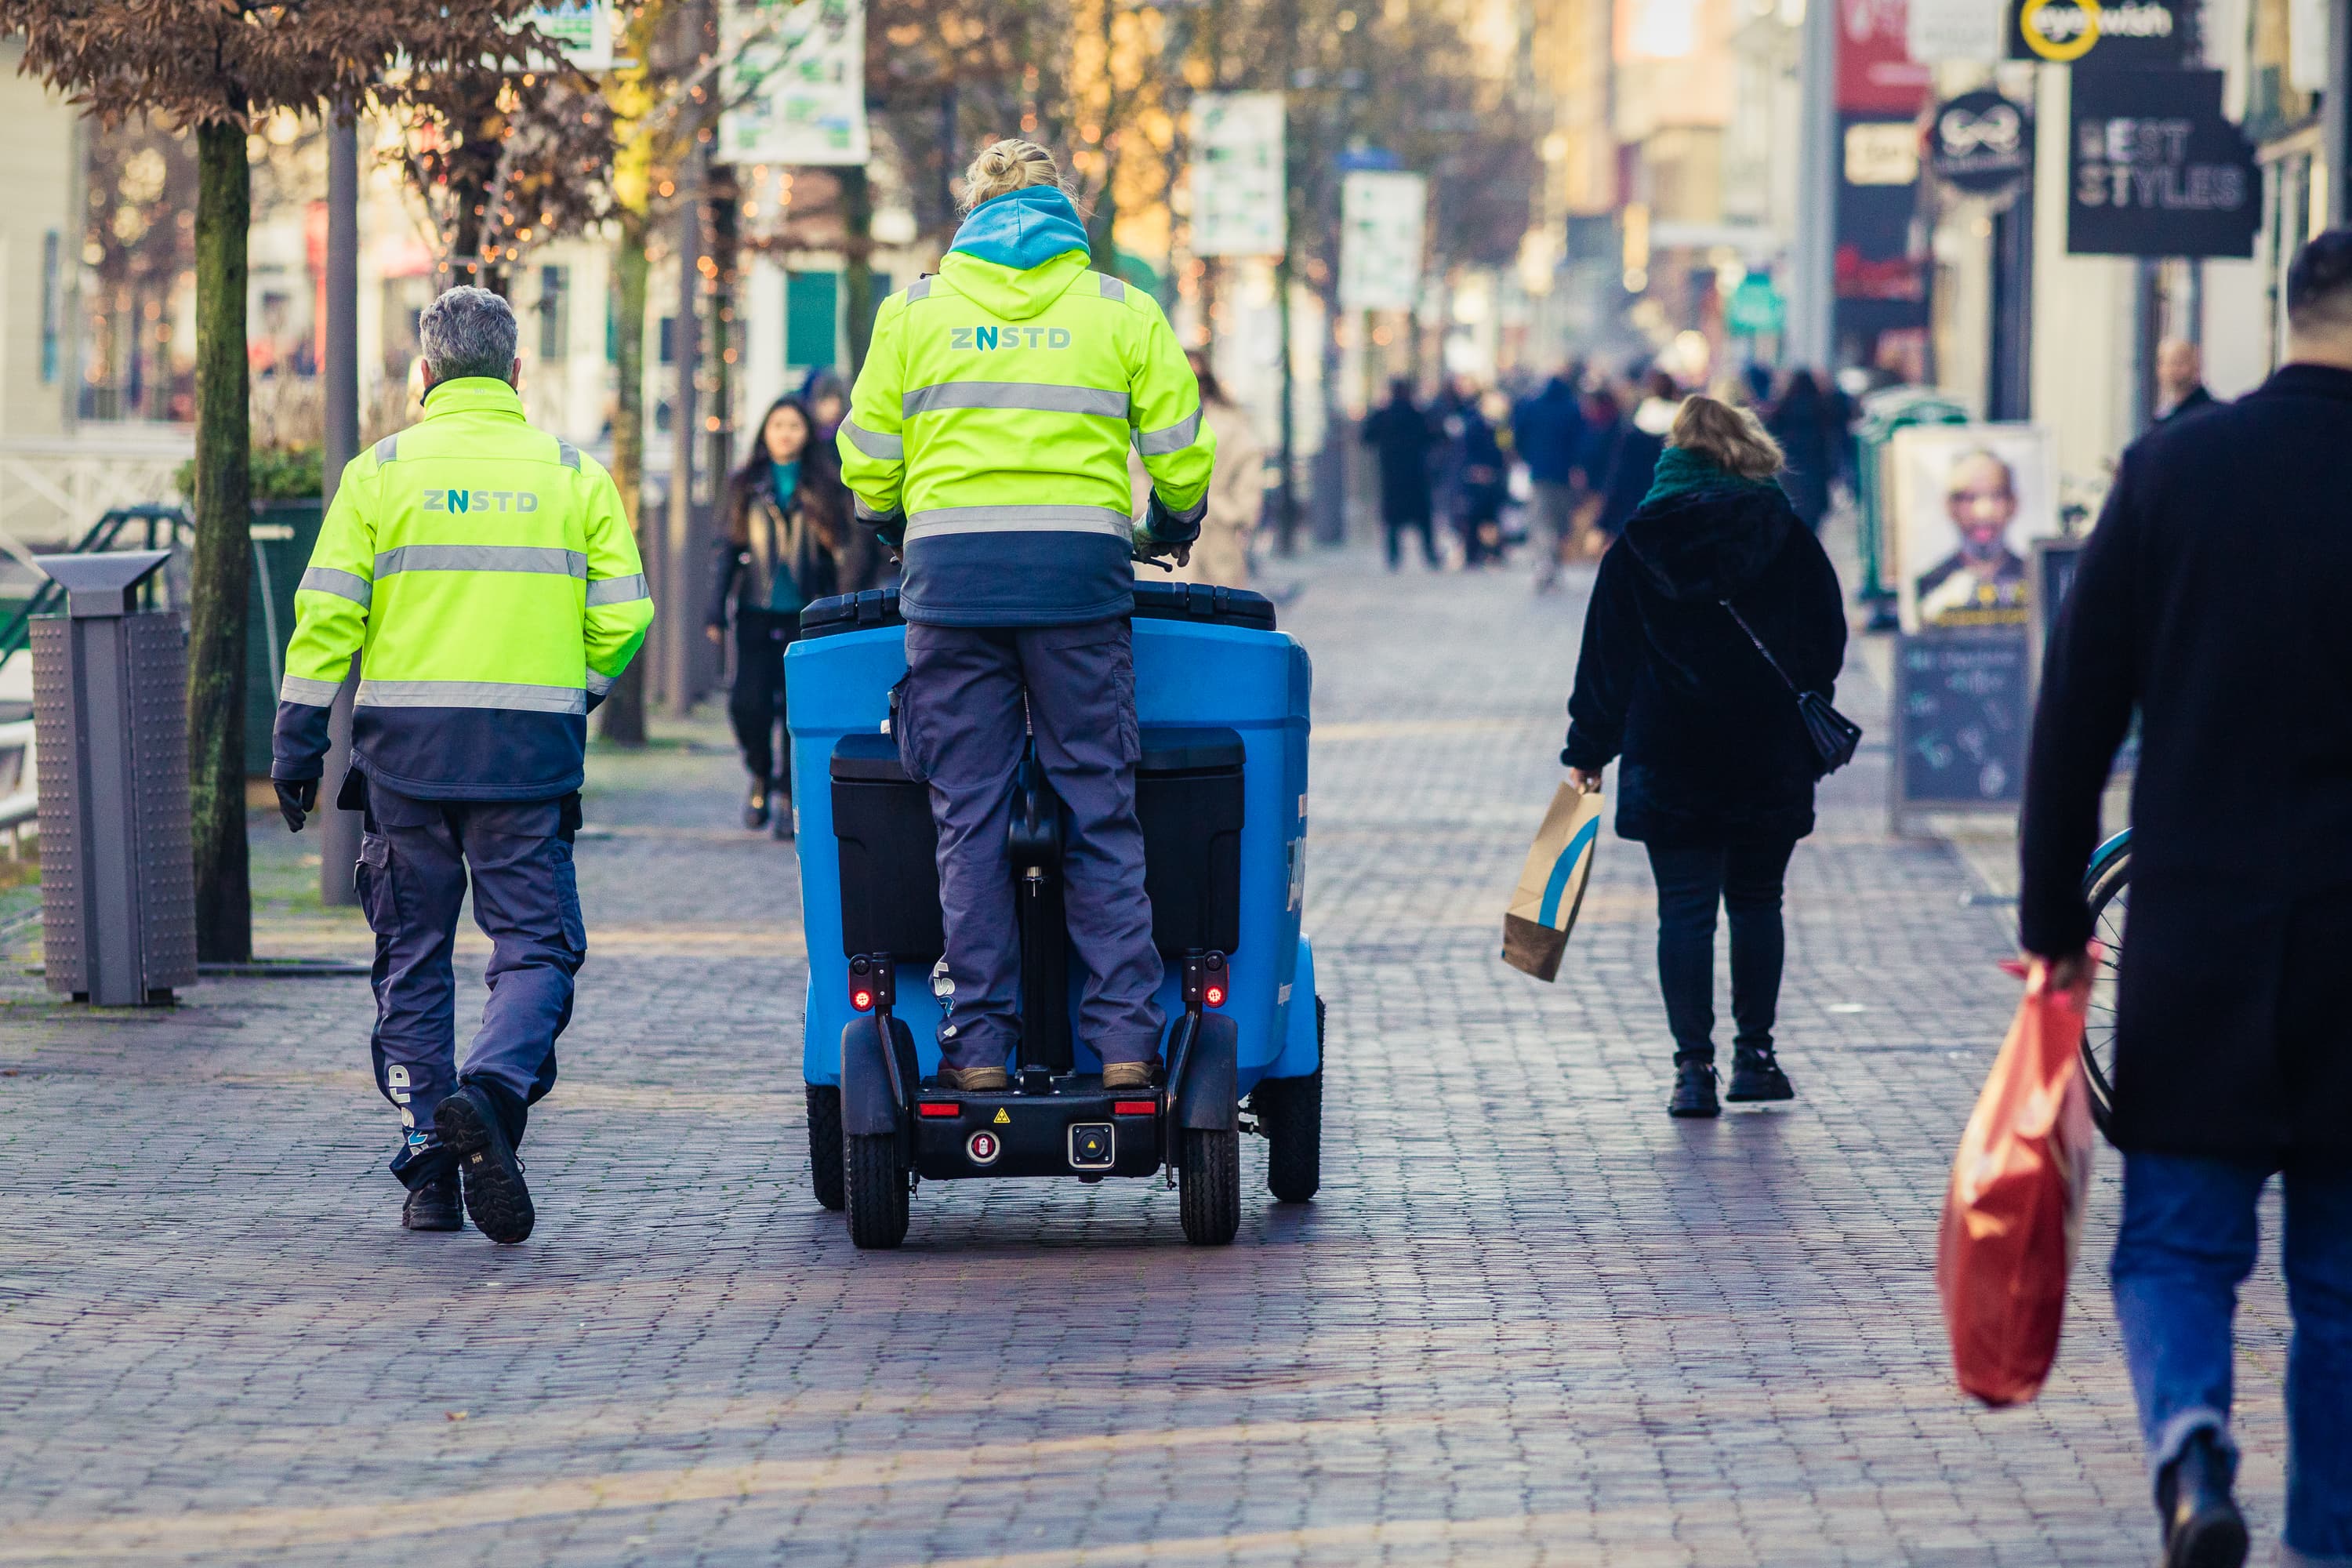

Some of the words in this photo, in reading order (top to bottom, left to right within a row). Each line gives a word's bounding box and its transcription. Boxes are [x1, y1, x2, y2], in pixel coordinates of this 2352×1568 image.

[2078, 163, 2247, 209] STYLES
[951, 326, 1070, 351] ZNSTD
[423, 489, 538, 514] ZNSTD
